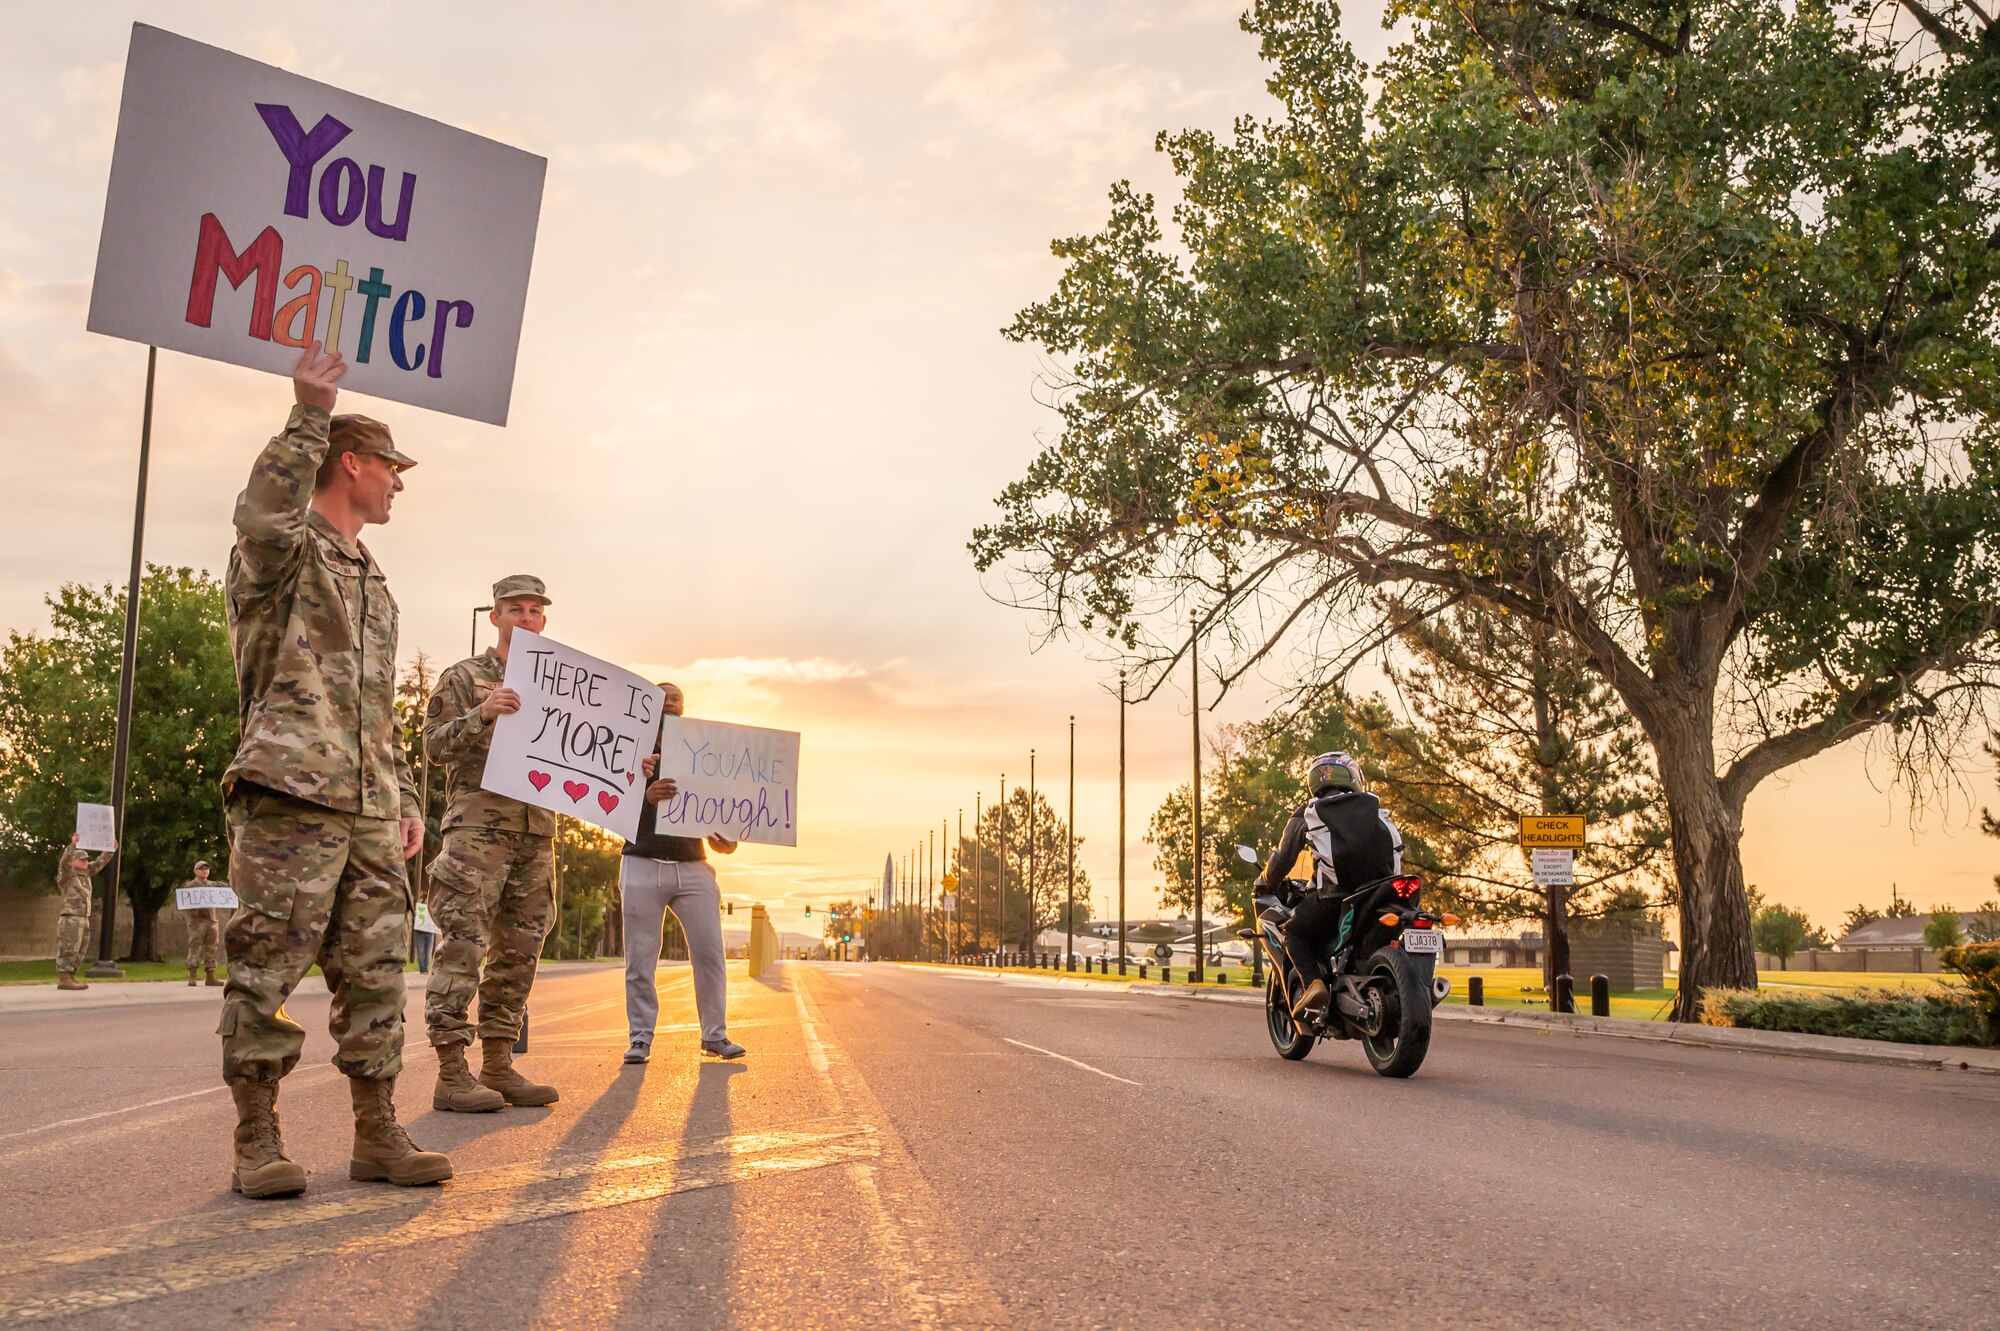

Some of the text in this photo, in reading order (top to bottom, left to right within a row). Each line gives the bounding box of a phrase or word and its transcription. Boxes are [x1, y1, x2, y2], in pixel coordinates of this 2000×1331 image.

[254, 102, 417, 242] You
[185, 212, 474, 378] Matter
[526, 650, 653, 724] THERE IS
[530, 705, 641, 787] MORE!
[661, 786, 791, 841] enough!
[1523, 834, 1583, 842] HEADLIGHTS
[1536, 821, 1569, 830] CHECK
[181, 890, 236, 905] PLEASE STA
[1408, 935, 1437, 946] CJA378
